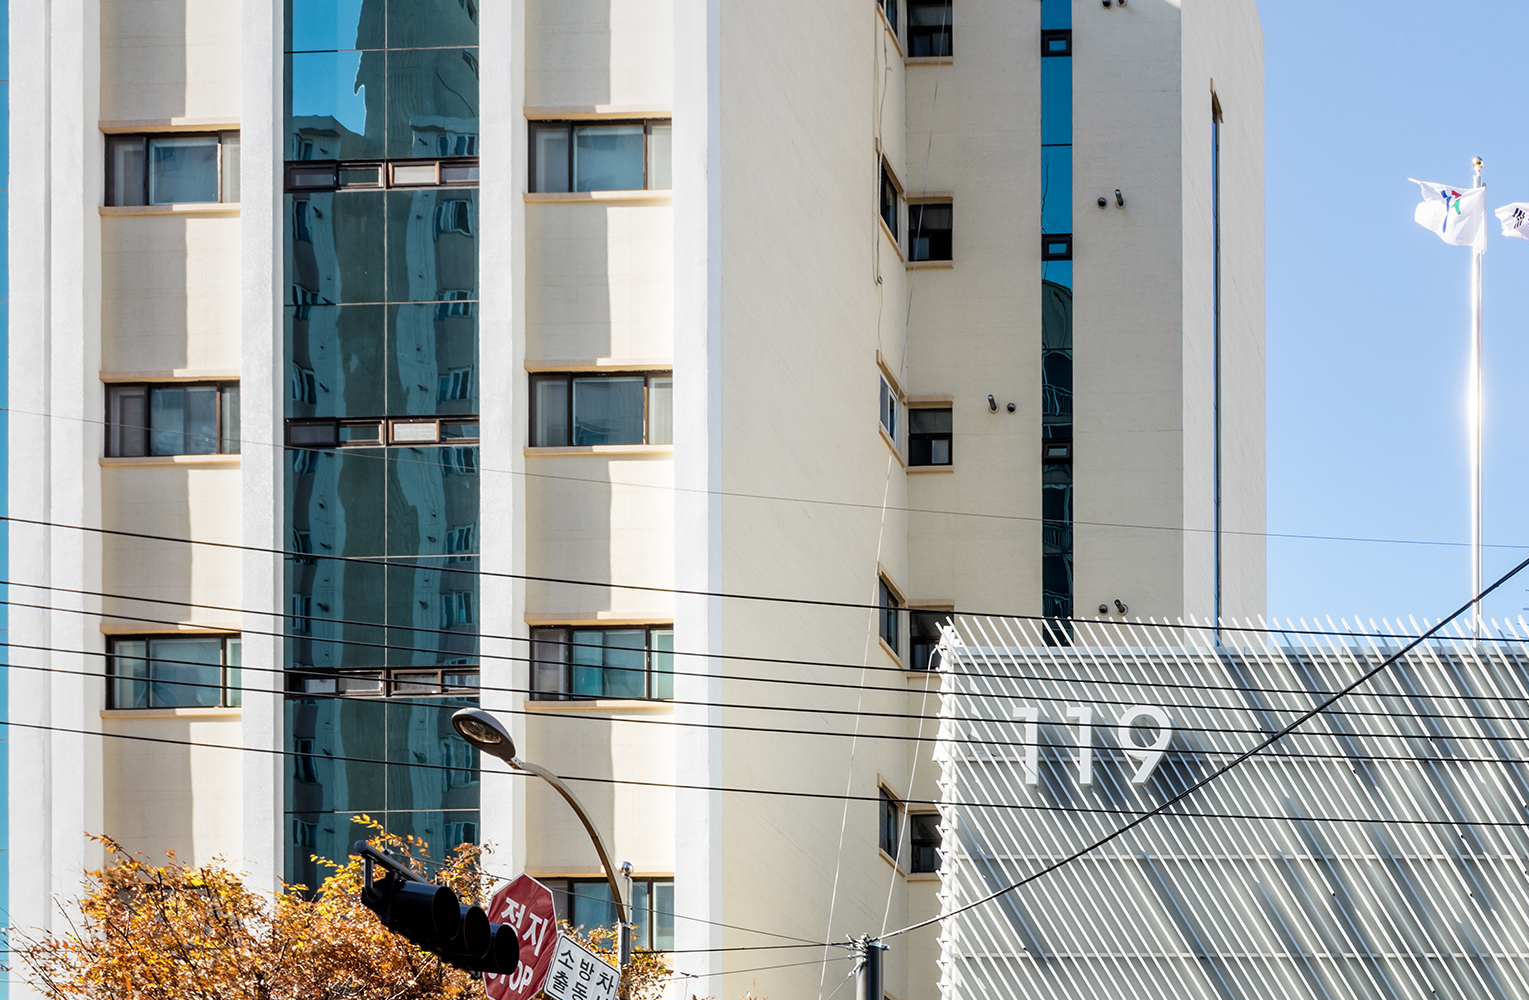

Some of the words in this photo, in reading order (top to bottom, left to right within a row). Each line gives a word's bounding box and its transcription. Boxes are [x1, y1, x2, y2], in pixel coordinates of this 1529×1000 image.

[1012, 705, 1172, 785] 119
[488, 960, 533, 994] OP
[558, 950, 614, 994] 소방차
